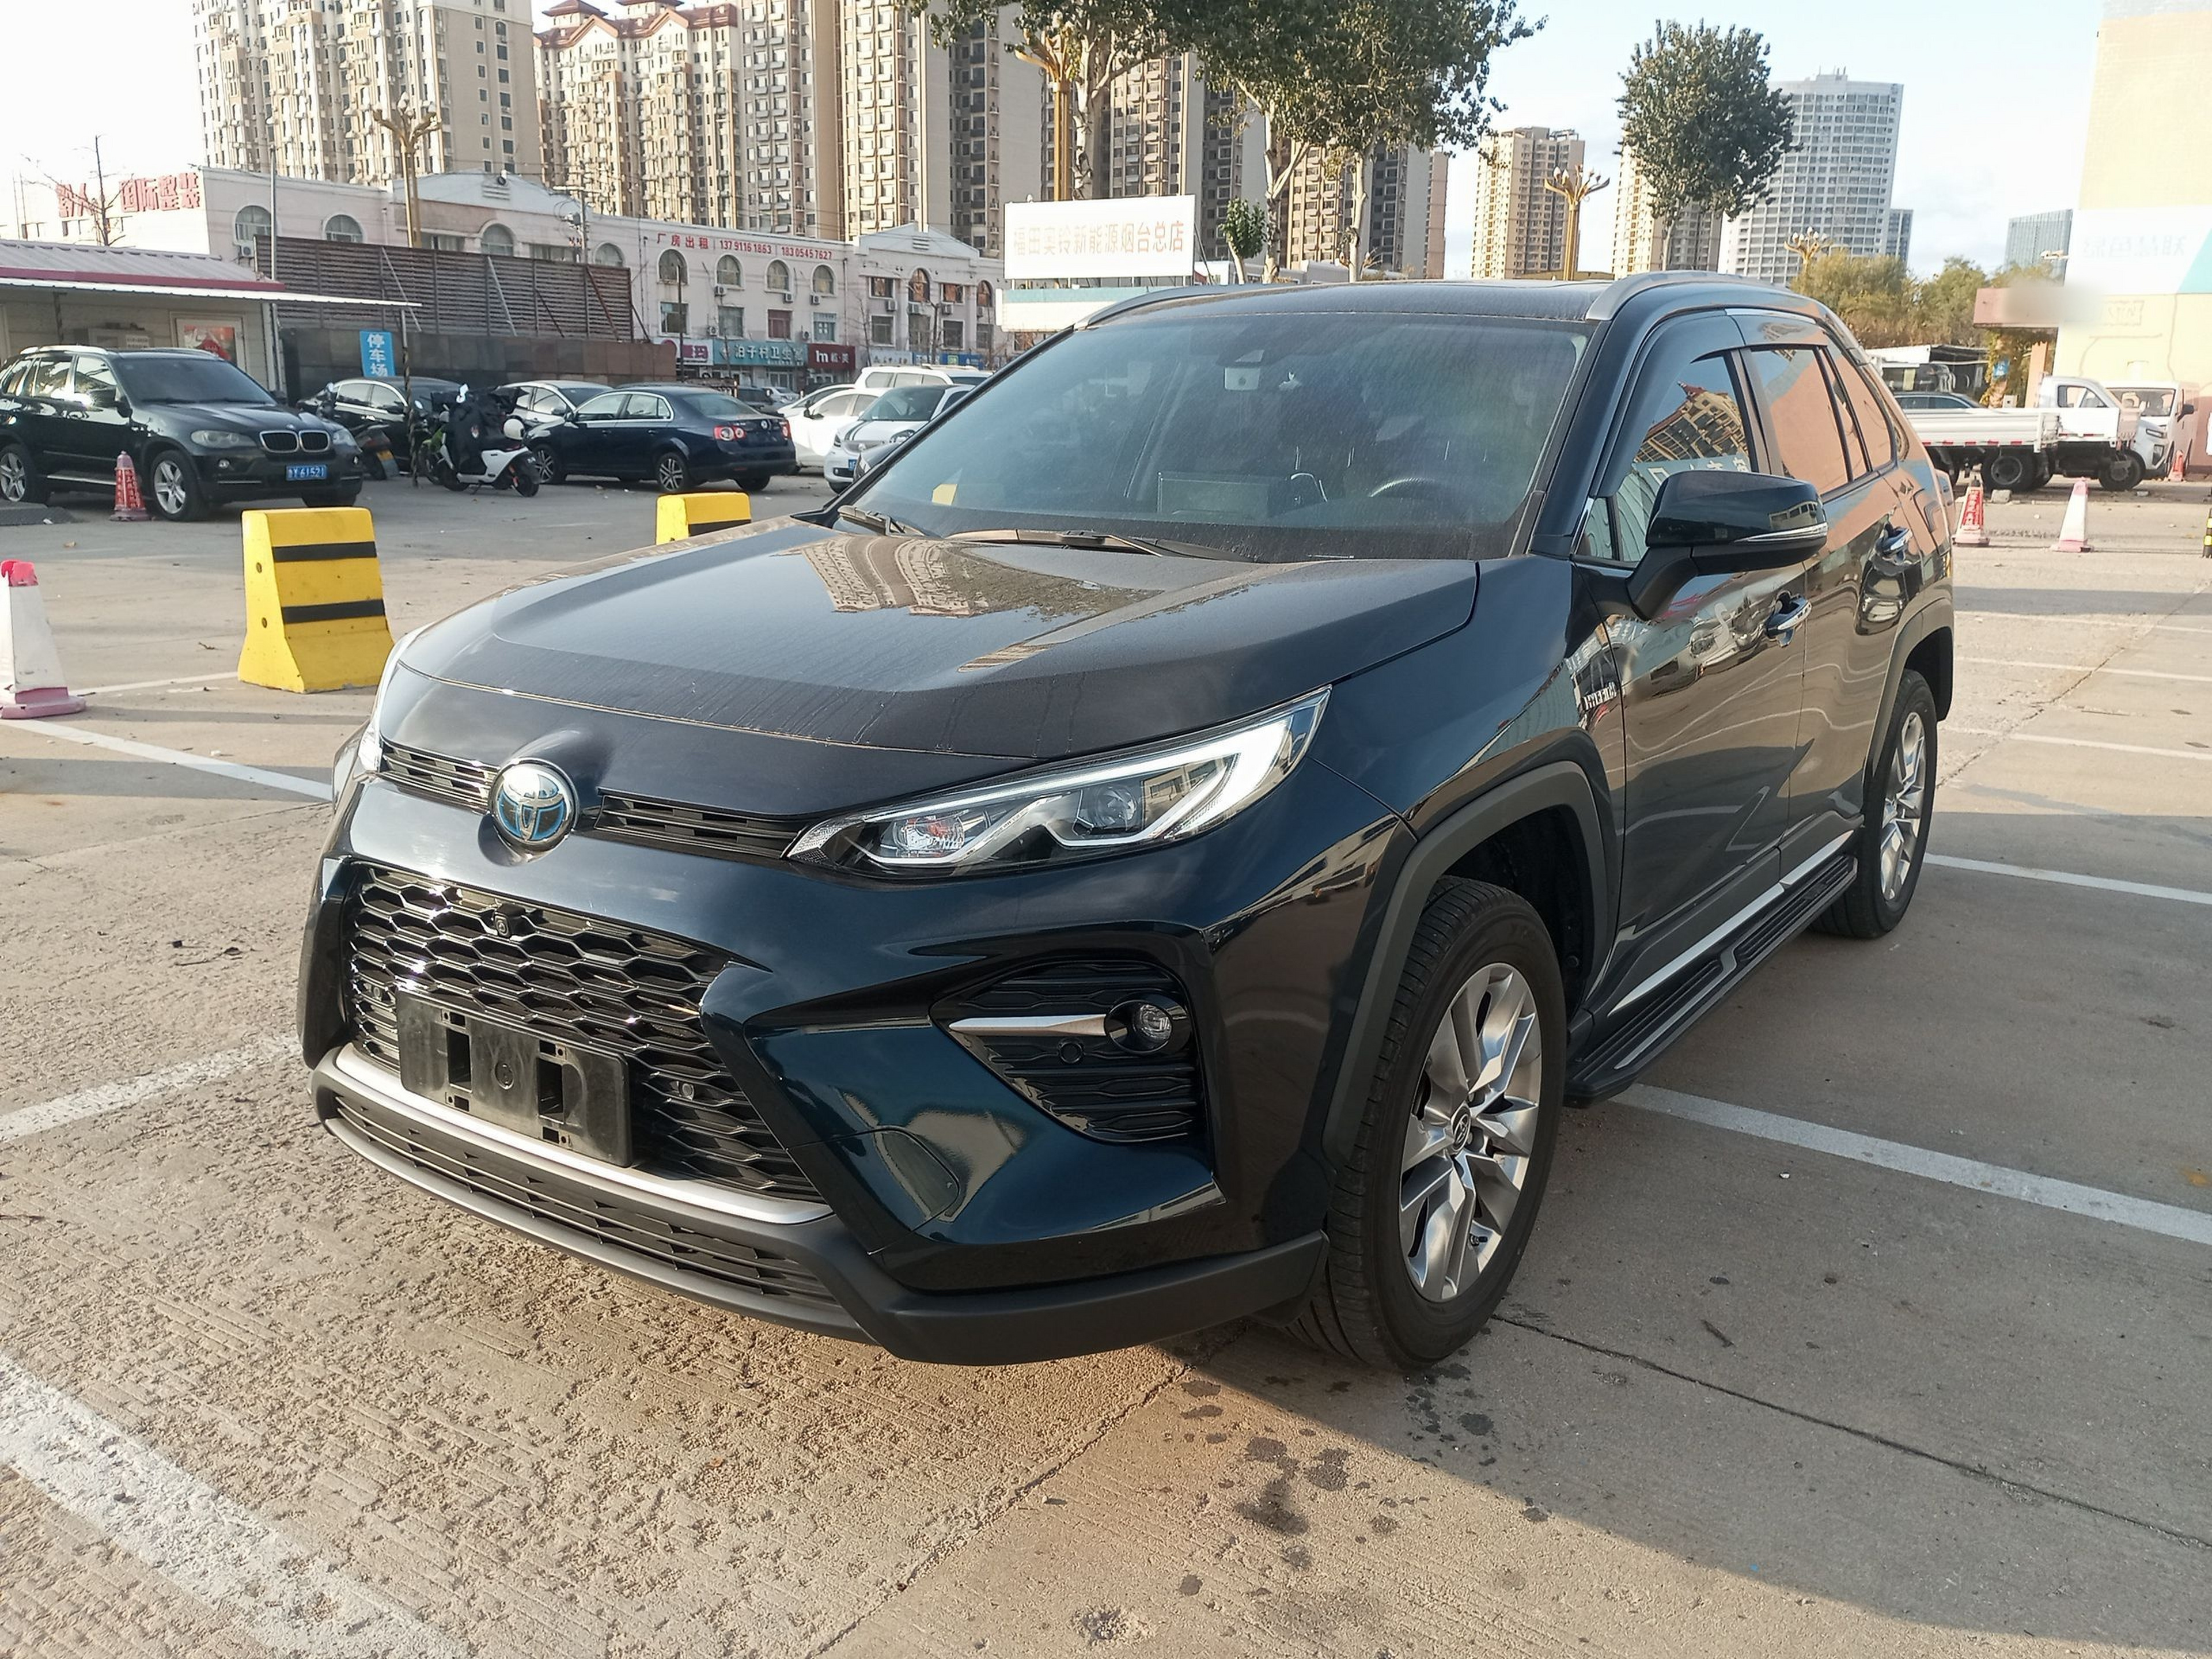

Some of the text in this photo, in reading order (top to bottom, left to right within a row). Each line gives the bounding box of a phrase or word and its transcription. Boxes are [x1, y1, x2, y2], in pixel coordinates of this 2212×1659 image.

[657, 233, 709, 249] 厂房出租
[366, 332, 388, 377] 停车场
